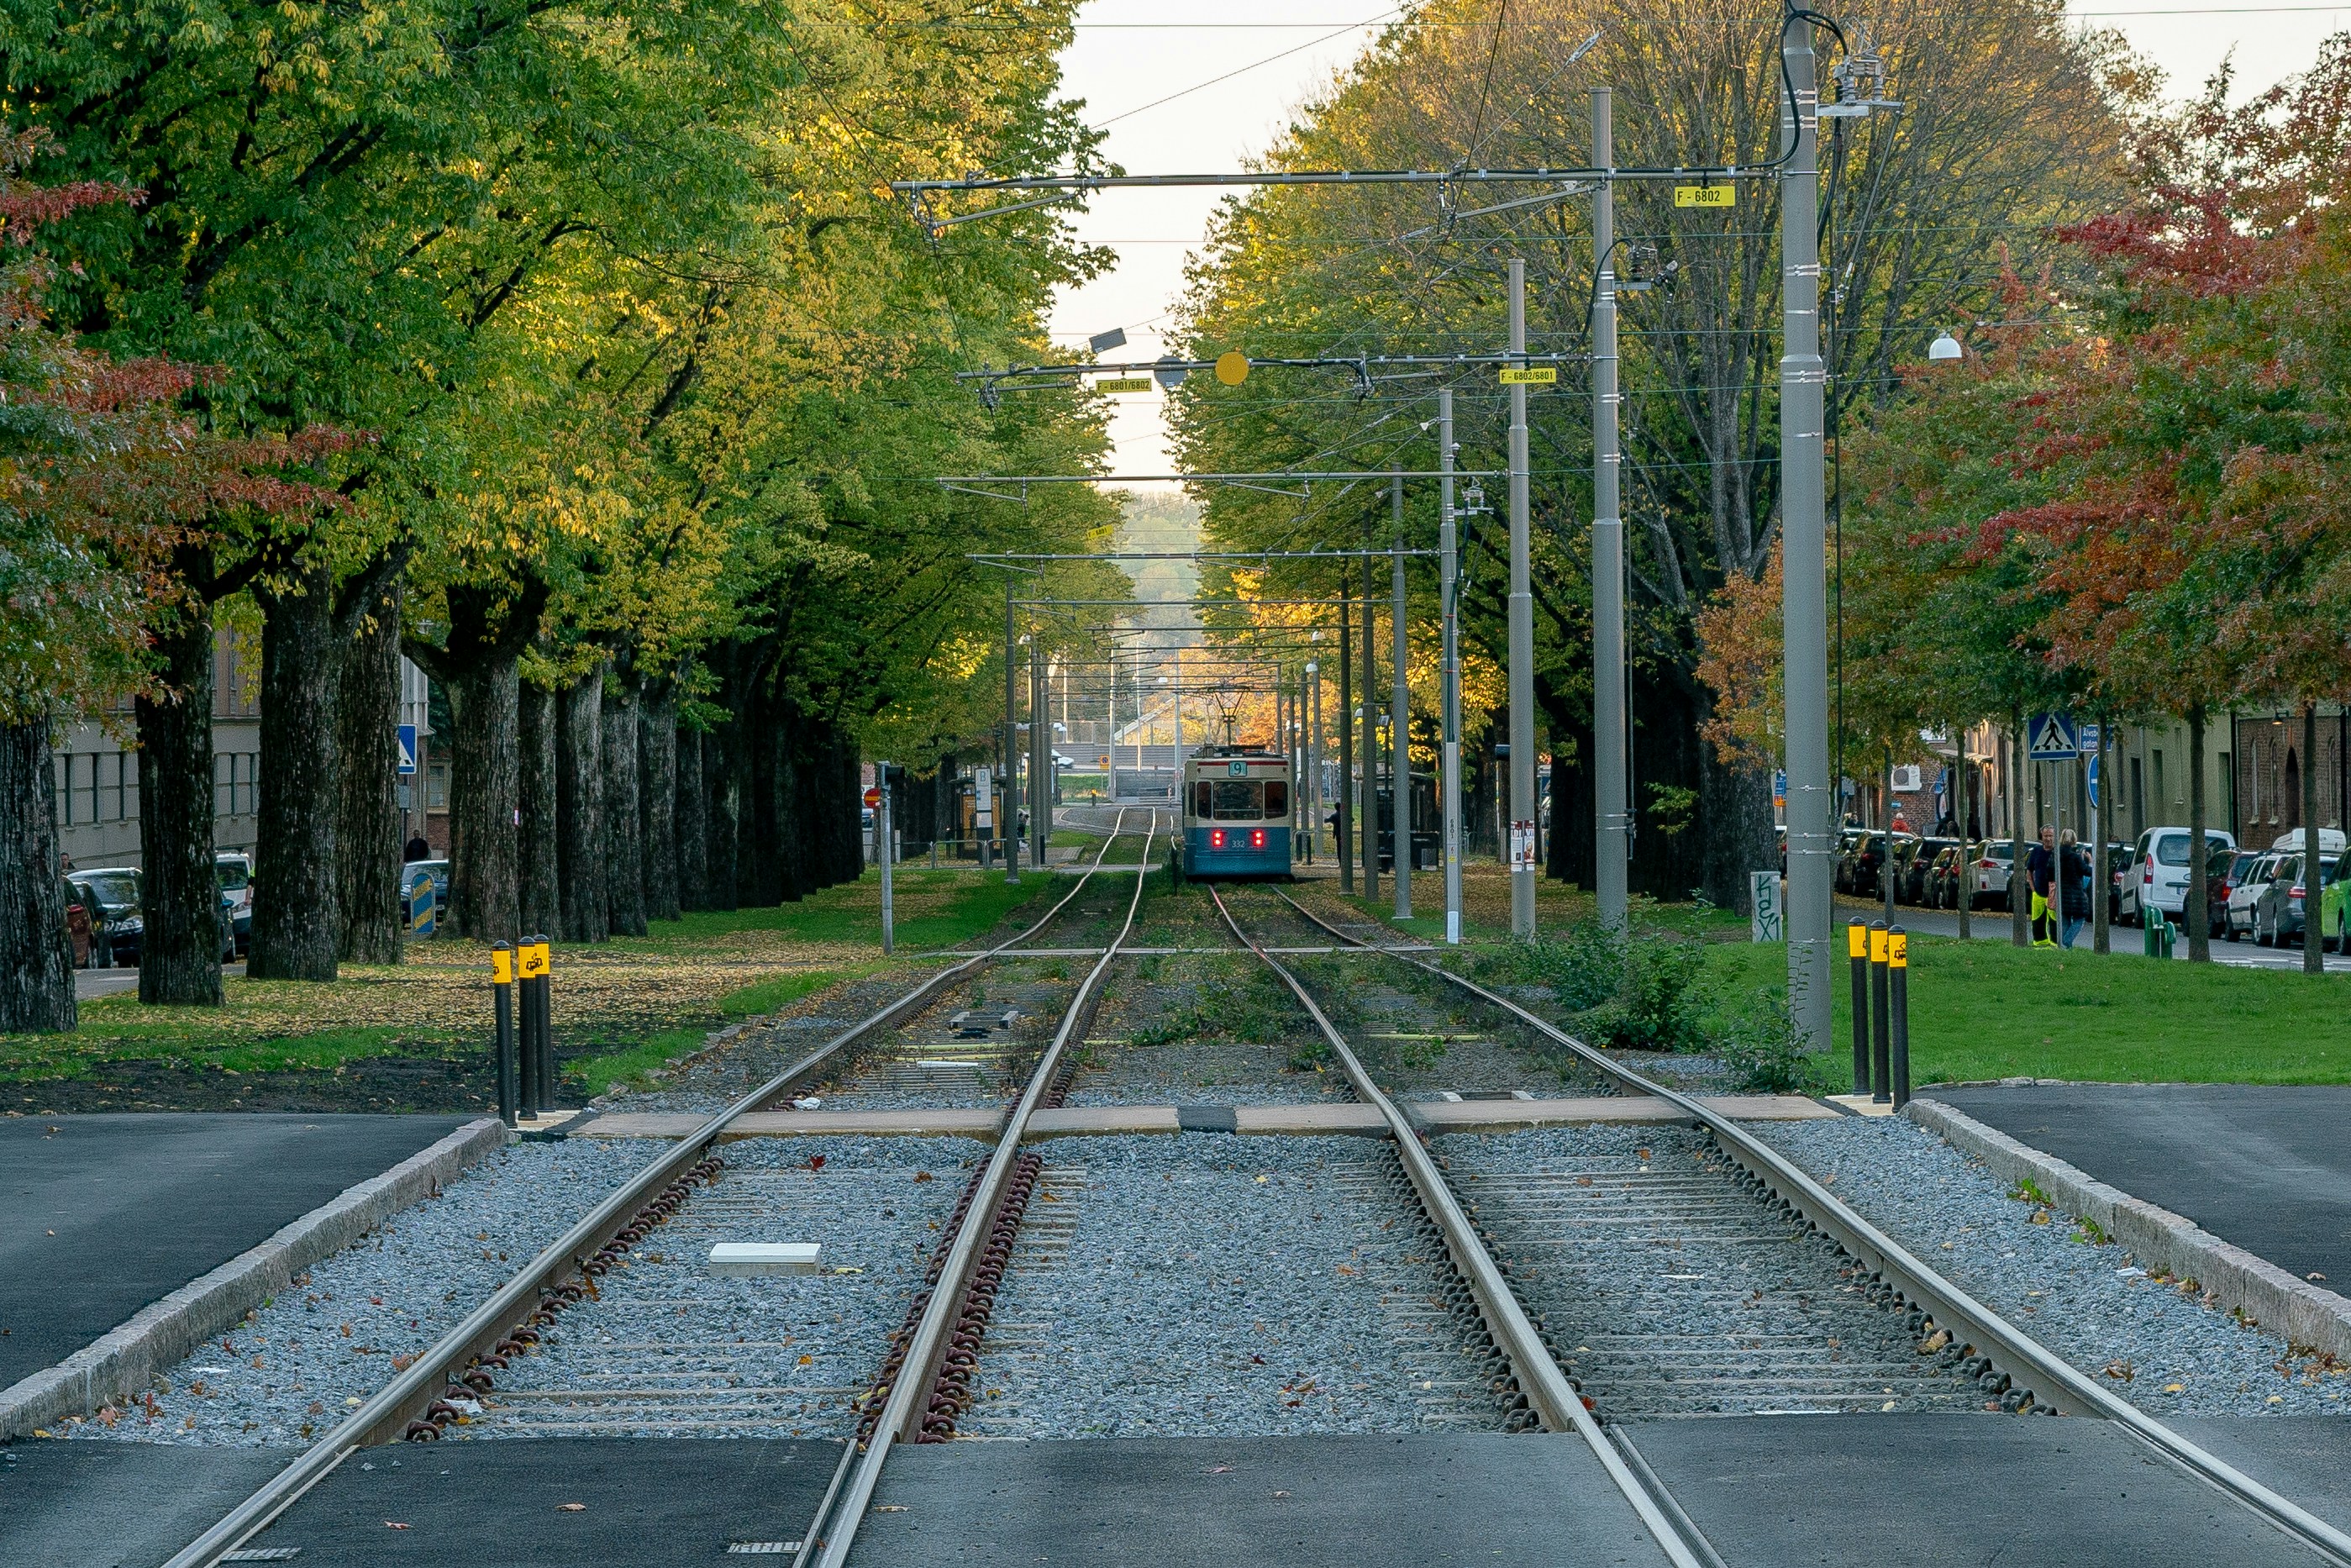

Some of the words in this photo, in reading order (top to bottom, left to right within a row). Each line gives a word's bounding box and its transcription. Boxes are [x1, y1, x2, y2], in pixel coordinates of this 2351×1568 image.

[1677, 191, 1683, 202] F
[1695, 190, 1721, 202] 6802
[1502, 372, 1506, 381] F
[1514, 371, 1553, 381] 6802/6801
[1110, 381, 1150, 391] 6801/6802
[1233, 763, 1242, 776] 9
[980, 771, 986, 781] B
[1232, 839, 1245, 848] 332
